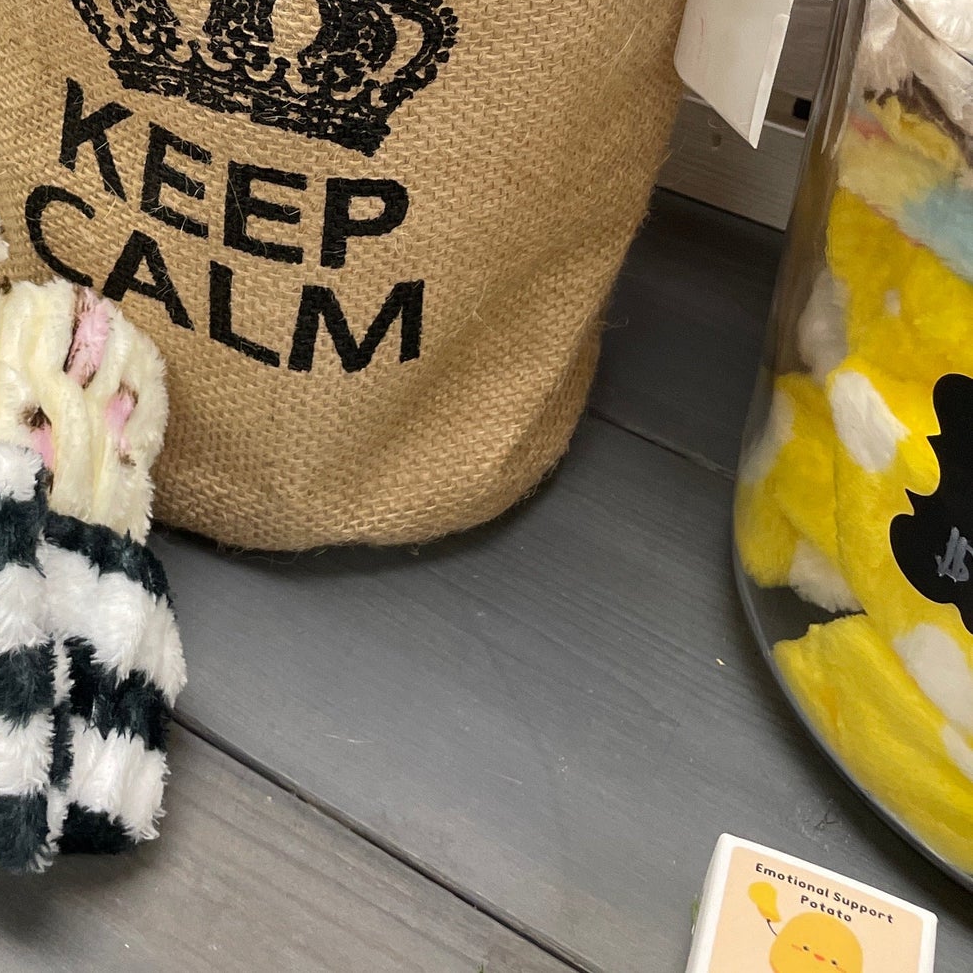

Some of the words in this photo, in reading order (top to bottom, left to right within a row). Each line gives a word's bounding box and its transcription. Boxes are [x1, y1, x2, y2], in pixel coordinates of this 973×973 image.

[58, 77, 410, 269] KEEP
[25, 185, 425, 373] CALM
[755, 862, 829, 898] Emotional
[833, 892, 894, 924] Support
[800, 894, 852, 922] Potato
